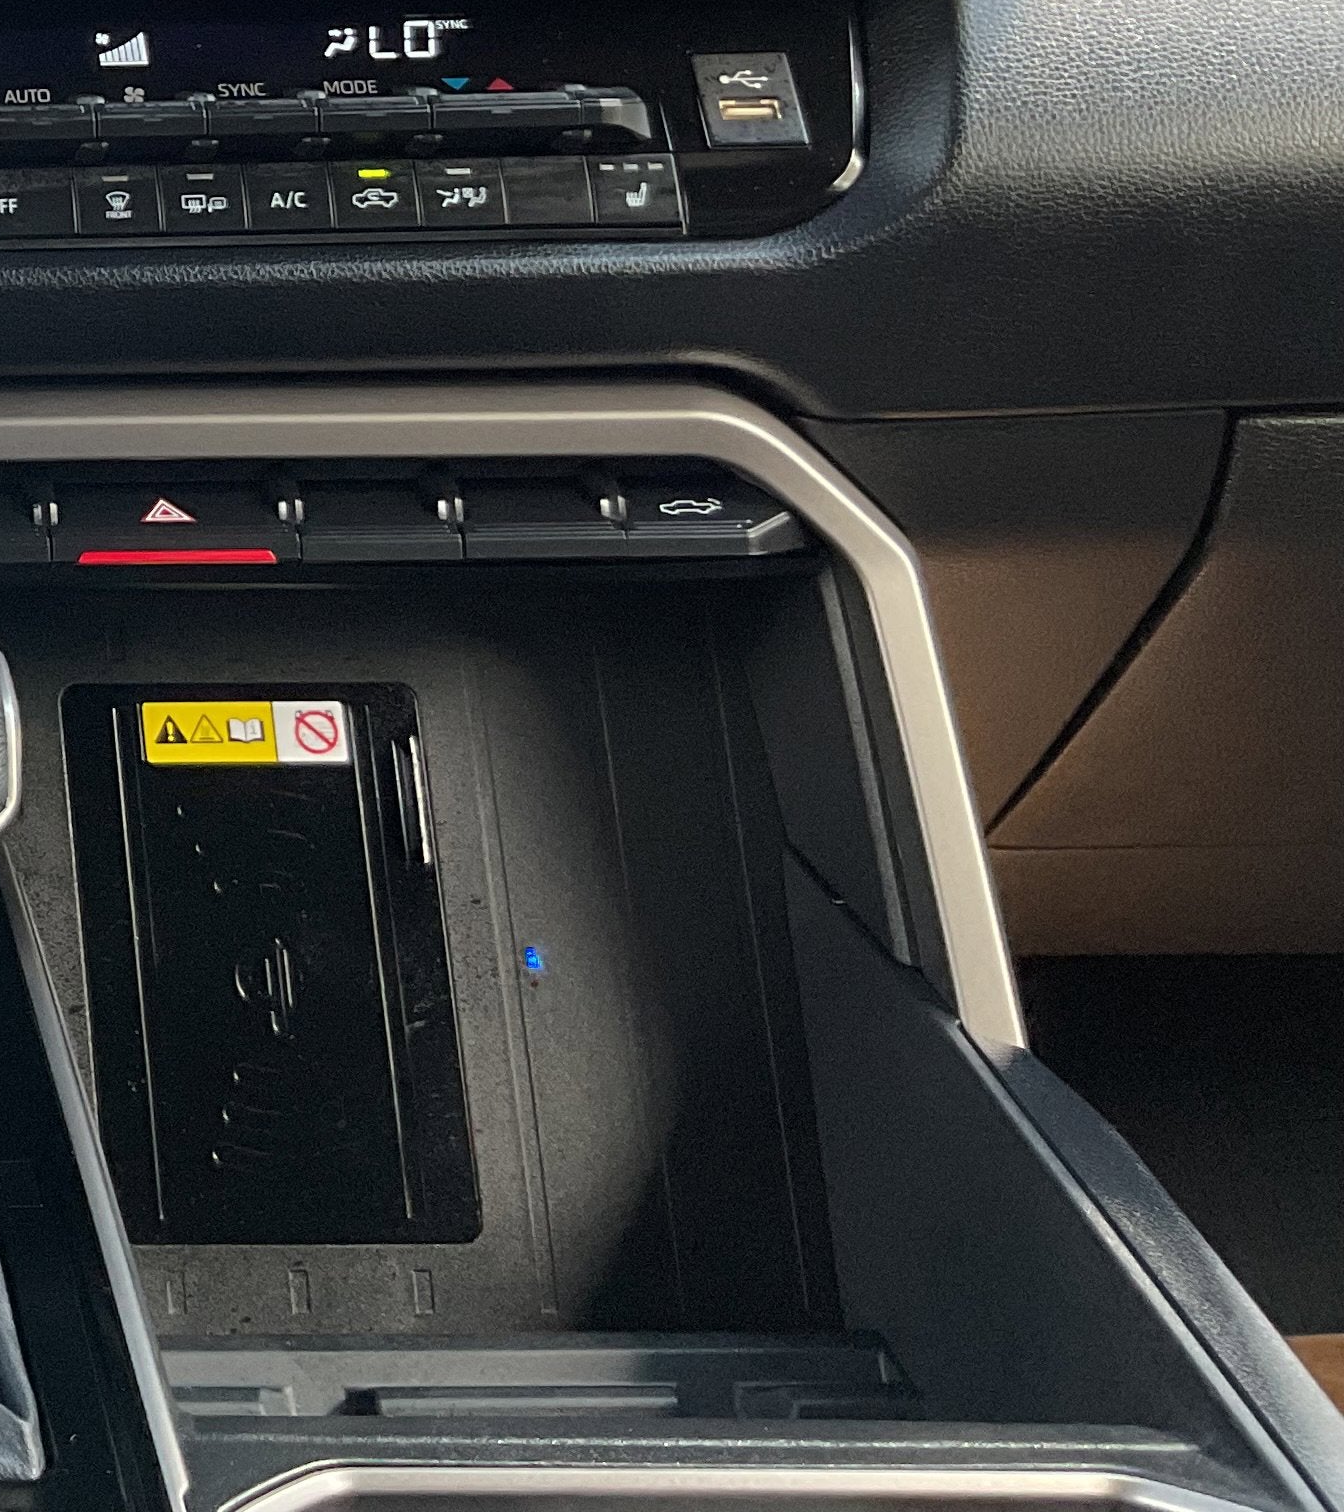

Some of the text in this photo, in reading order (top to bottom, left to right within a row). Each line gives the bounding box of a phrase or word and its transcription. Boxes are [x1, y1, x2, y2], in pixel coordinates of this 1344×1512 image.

[435, 19, 469, 30] SYNC
[218, 83, 267, 98] SYNC
[323, 79, 379, 96] MODE
[4, 88, 52, 105] AUTO
[270, 190, 307, 210] A/C
